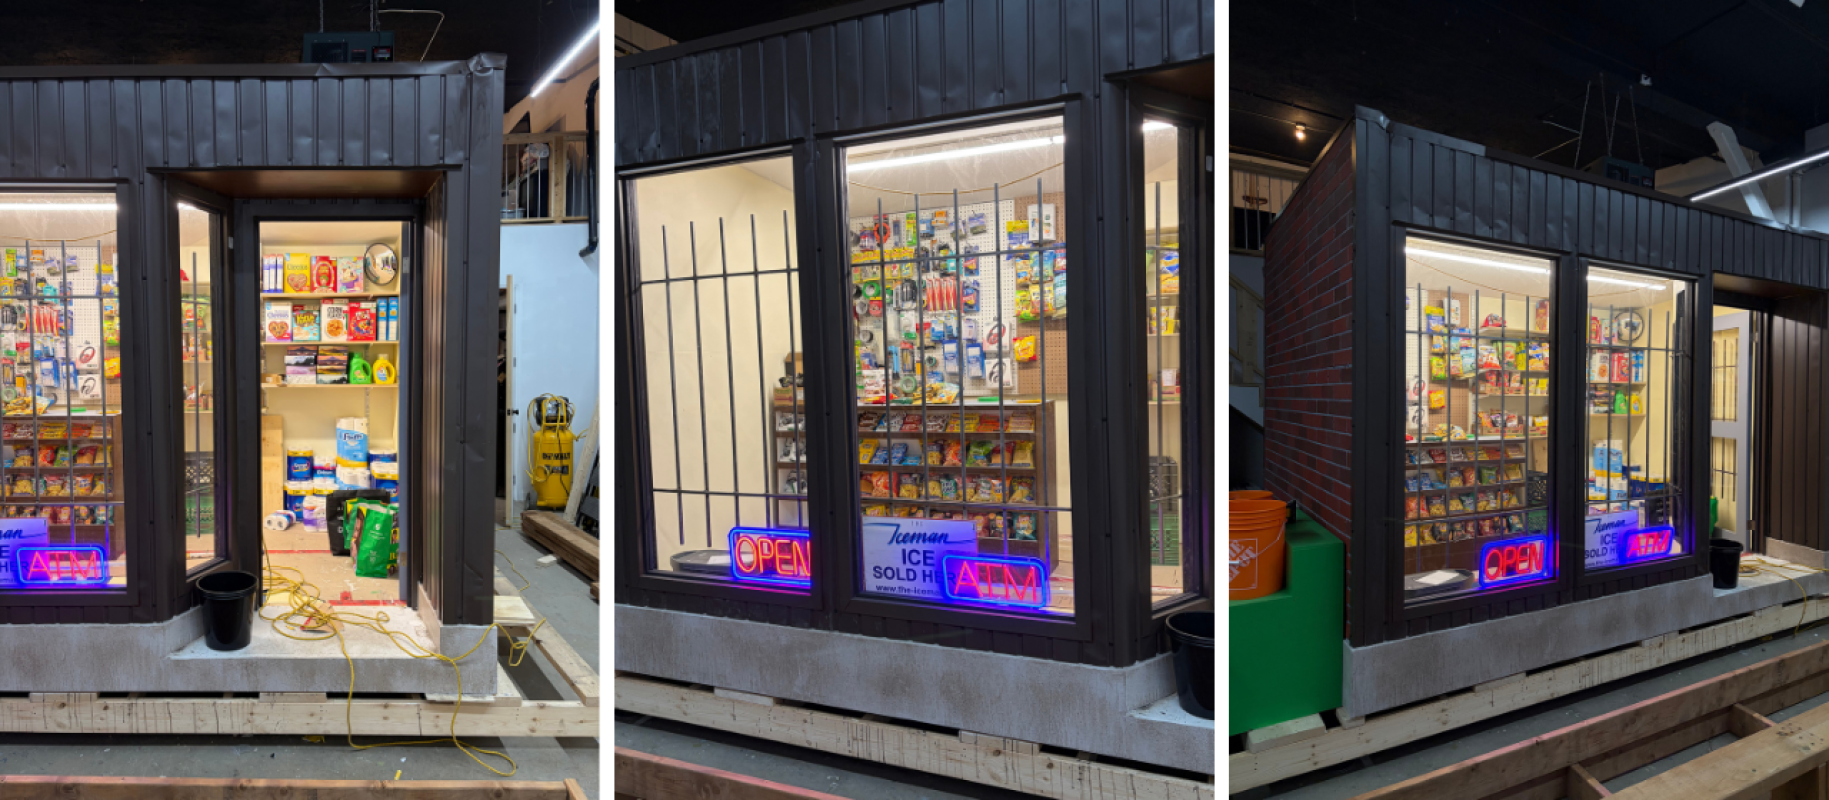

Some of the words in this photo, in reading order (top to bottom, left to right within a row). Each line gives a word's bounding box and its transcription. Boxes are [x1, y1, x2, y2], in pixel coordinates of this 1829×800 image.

[863, 522, 949, 546] Iceman
[1600, 532, 1619, 546] ICE
[1627, 530, 1669, 557] ATM
[27, 550, 98, 580] ATM
[735, 535, 811, 577] OPEN
[901, 548, 935, 567] ICE
[1485, 543, 1544, 580] OPEN
[872, 565, 917, 582] SOLD
[954, 561, 1037, 603] ATM
